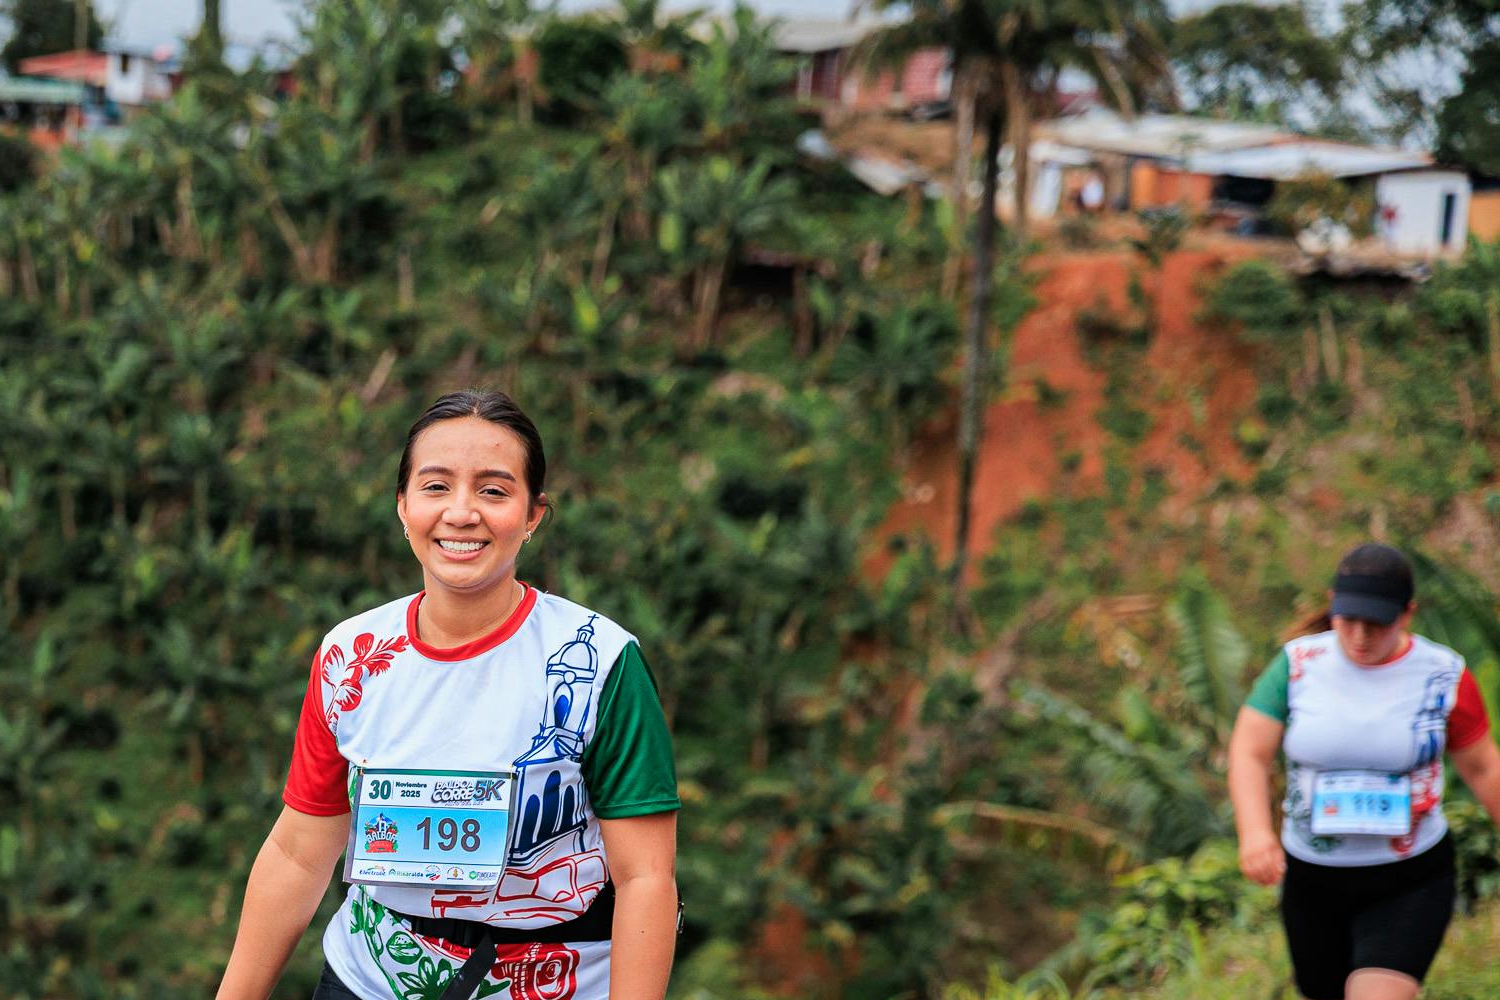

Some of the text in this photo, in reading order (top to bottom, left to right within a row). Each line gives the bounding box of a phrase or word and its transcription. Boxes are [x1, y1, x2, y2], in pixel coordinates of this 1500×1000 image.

[368, 779, 392, 800] 30
[401, 790, 421, 798] 2025
[431, 788, 474, 803] CORRE
[473, 780, 506, 801] 5K
[365, 831, 398, 843] BALBOA
[417, 817, 481, 852] 198
